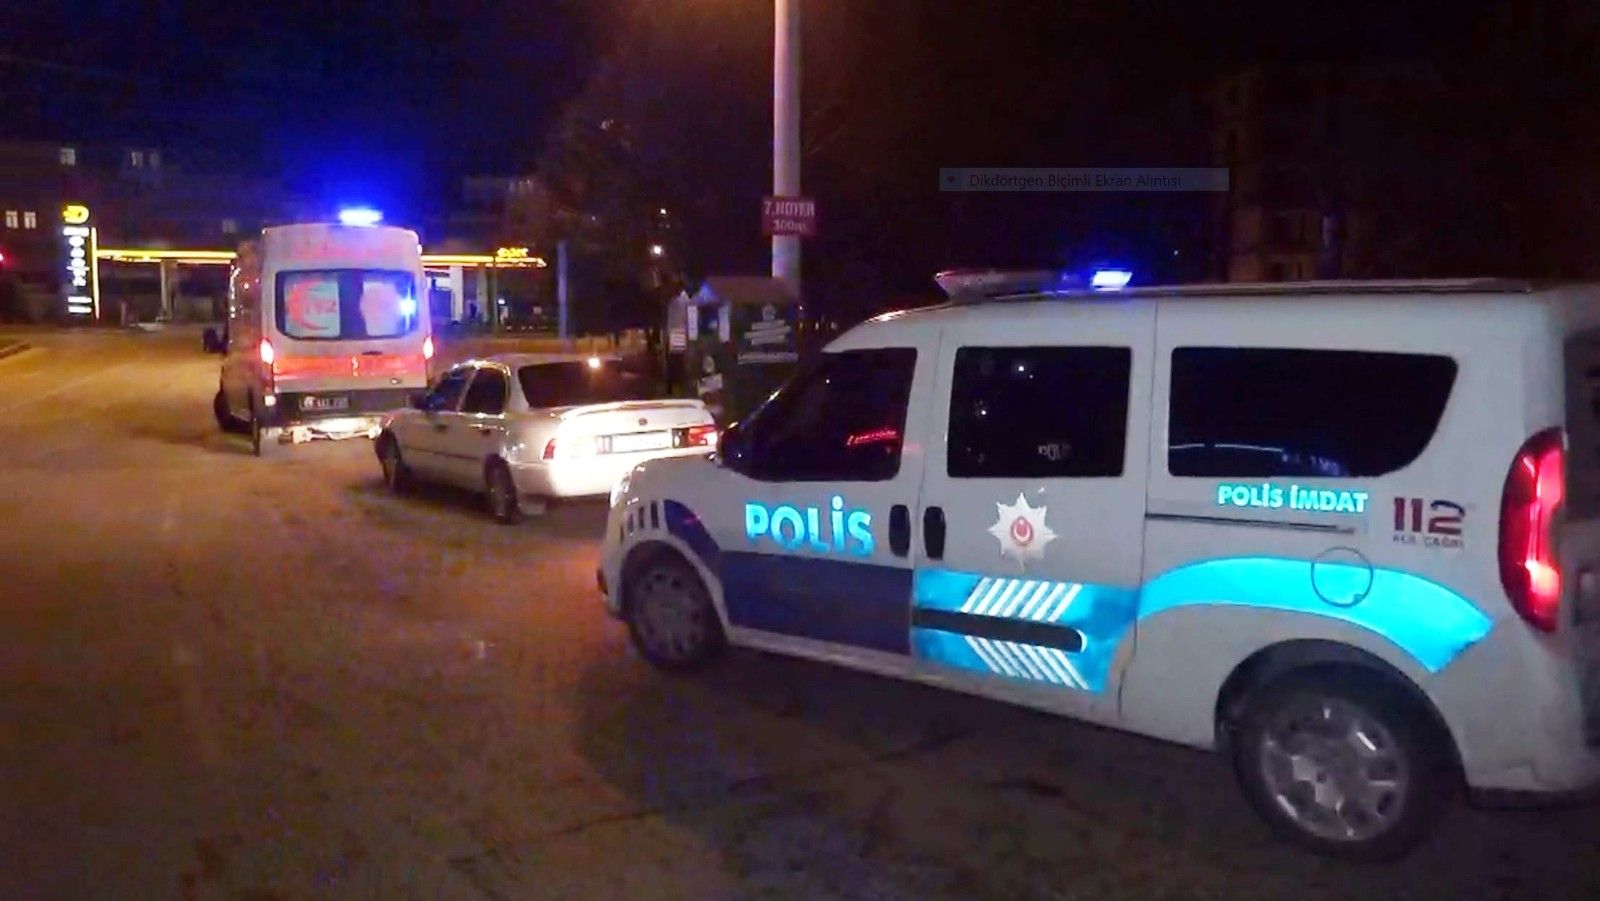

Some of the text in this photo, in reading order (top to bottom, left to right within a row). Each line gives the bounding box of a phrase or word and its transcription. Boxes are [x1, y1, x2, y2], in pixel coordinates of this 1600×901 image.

[1218, 483, 1369, 513] POLİS İMDAT
[1393, 496, 1466, 535] 112
[744, 495, 875, 557] POLİS
